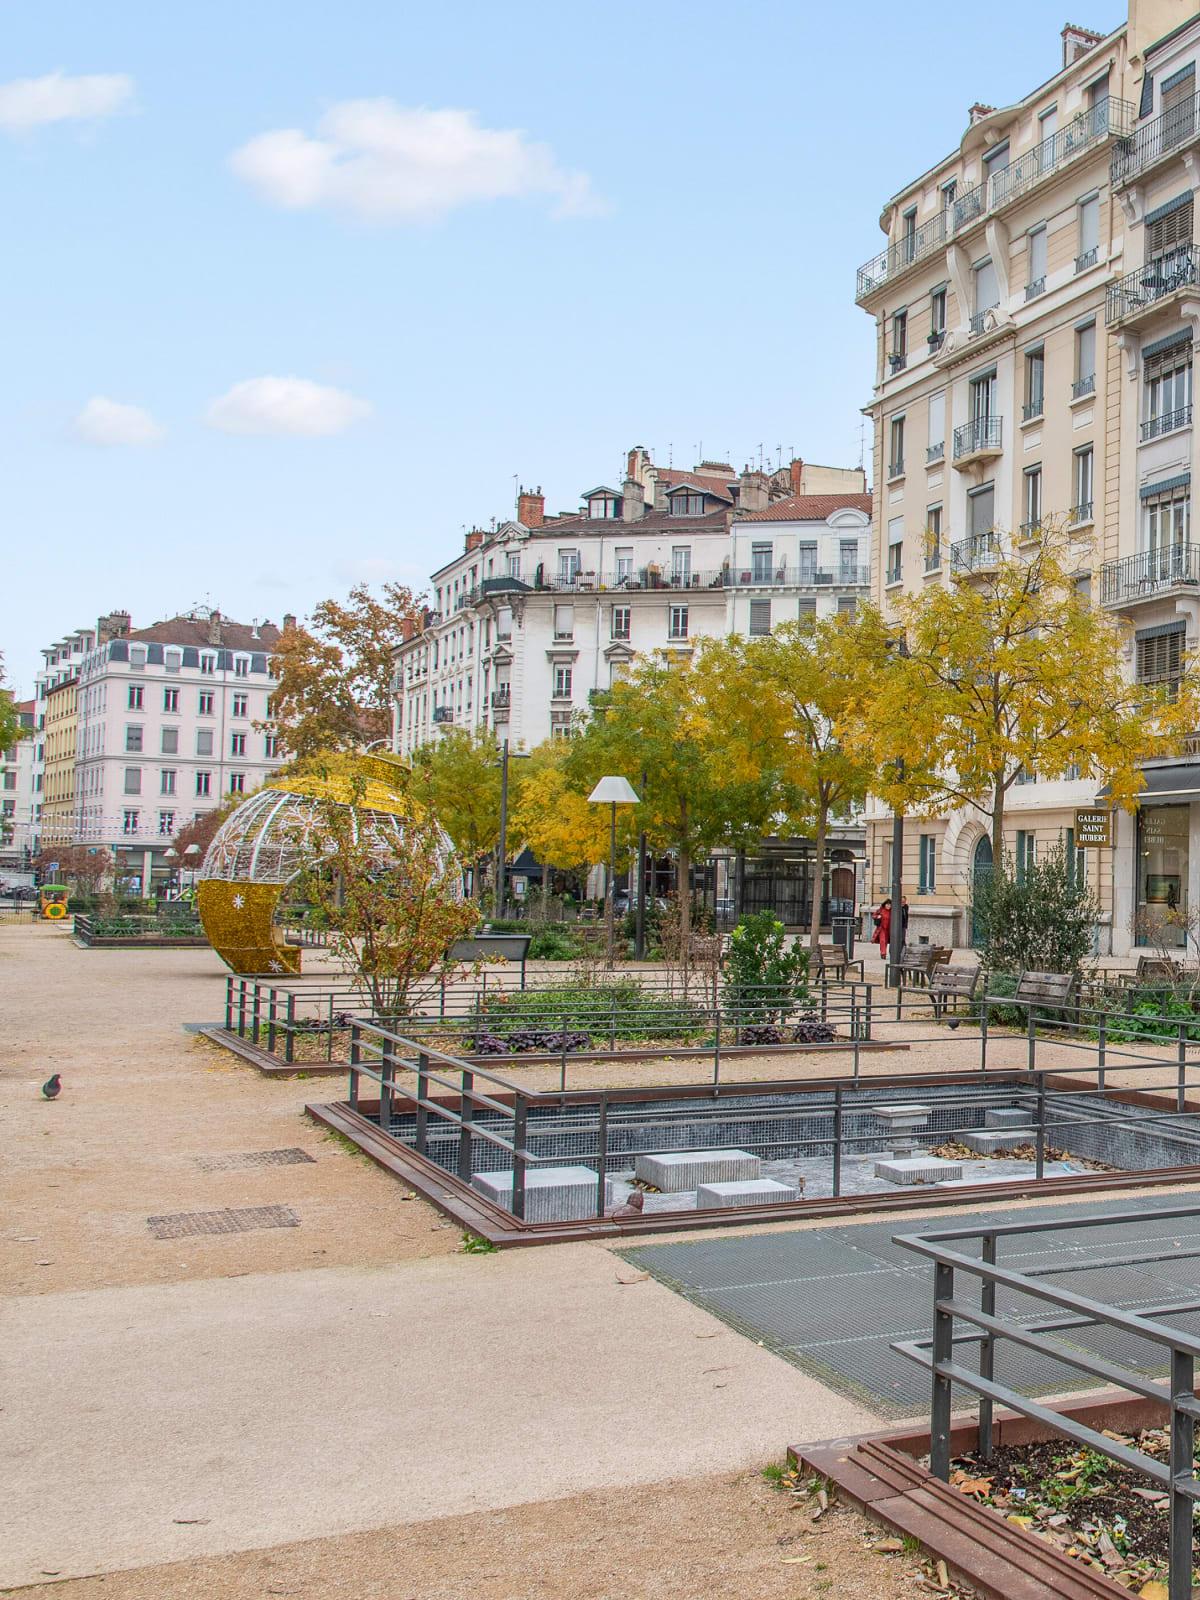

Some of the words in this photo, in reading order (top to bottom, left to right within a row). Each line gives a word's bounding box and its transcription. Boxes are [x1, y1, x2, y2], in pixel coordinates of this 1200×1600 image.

[1078, 815, 1108, 823] GALERIE
[1082, 824, 1104, 832] SAINT
[1080, 834, 1107, 842] HUBERT
